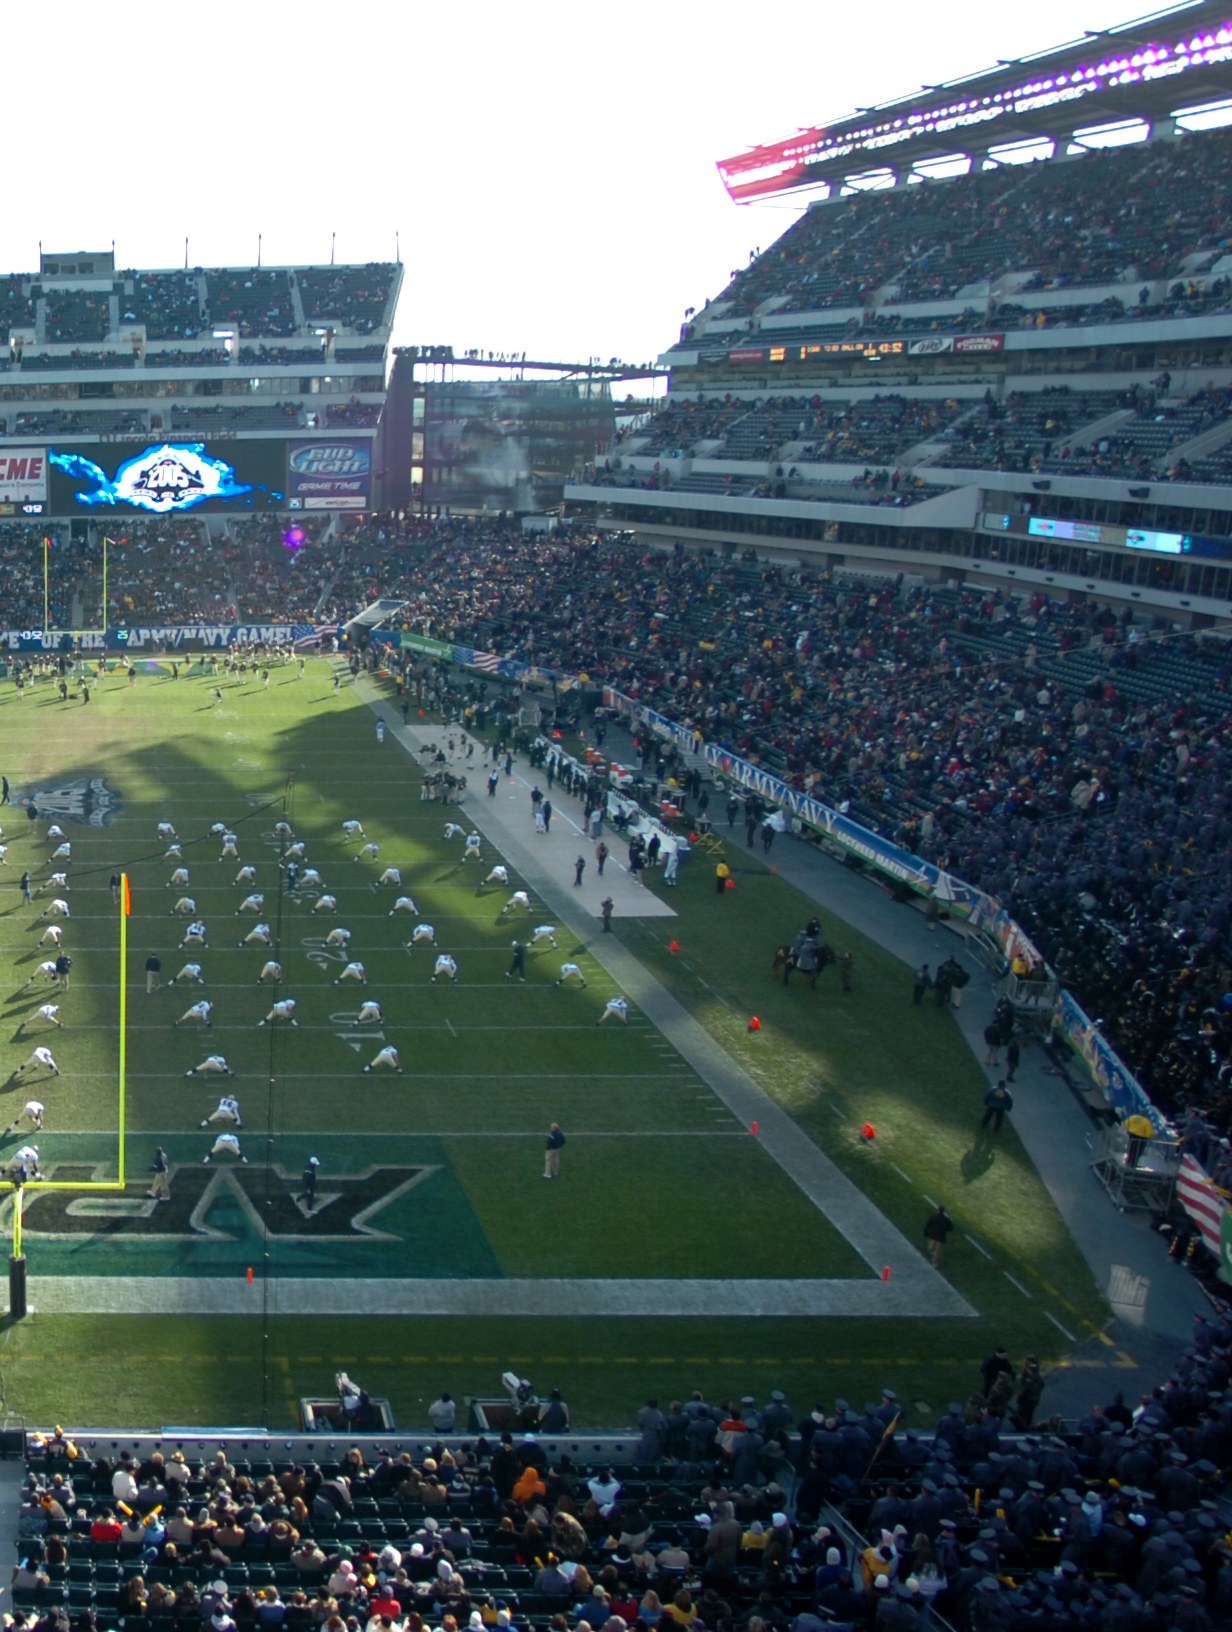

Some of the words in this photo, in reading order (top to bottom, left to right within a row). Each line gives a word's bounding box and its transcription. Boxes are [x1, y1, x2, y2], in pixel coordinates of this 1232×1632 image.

[309, 448, 353, 461] BUD
[148, 464, 190, 488] 2005
[299, 460, 367, 474] LIGHT
[298, 482, 332, 491] GAME
[334, 481, 362, 490] TIME
[41, 632, 63, 649] OF
[70, 631, 105, 649] THE
[236, 628, 292, 646] GAME!
[731, 761, 838, 834] ARMY/NAVY
[836, 830, 876, 862] LOCKHEED
[874, 852, 909, 881] MARTIN
